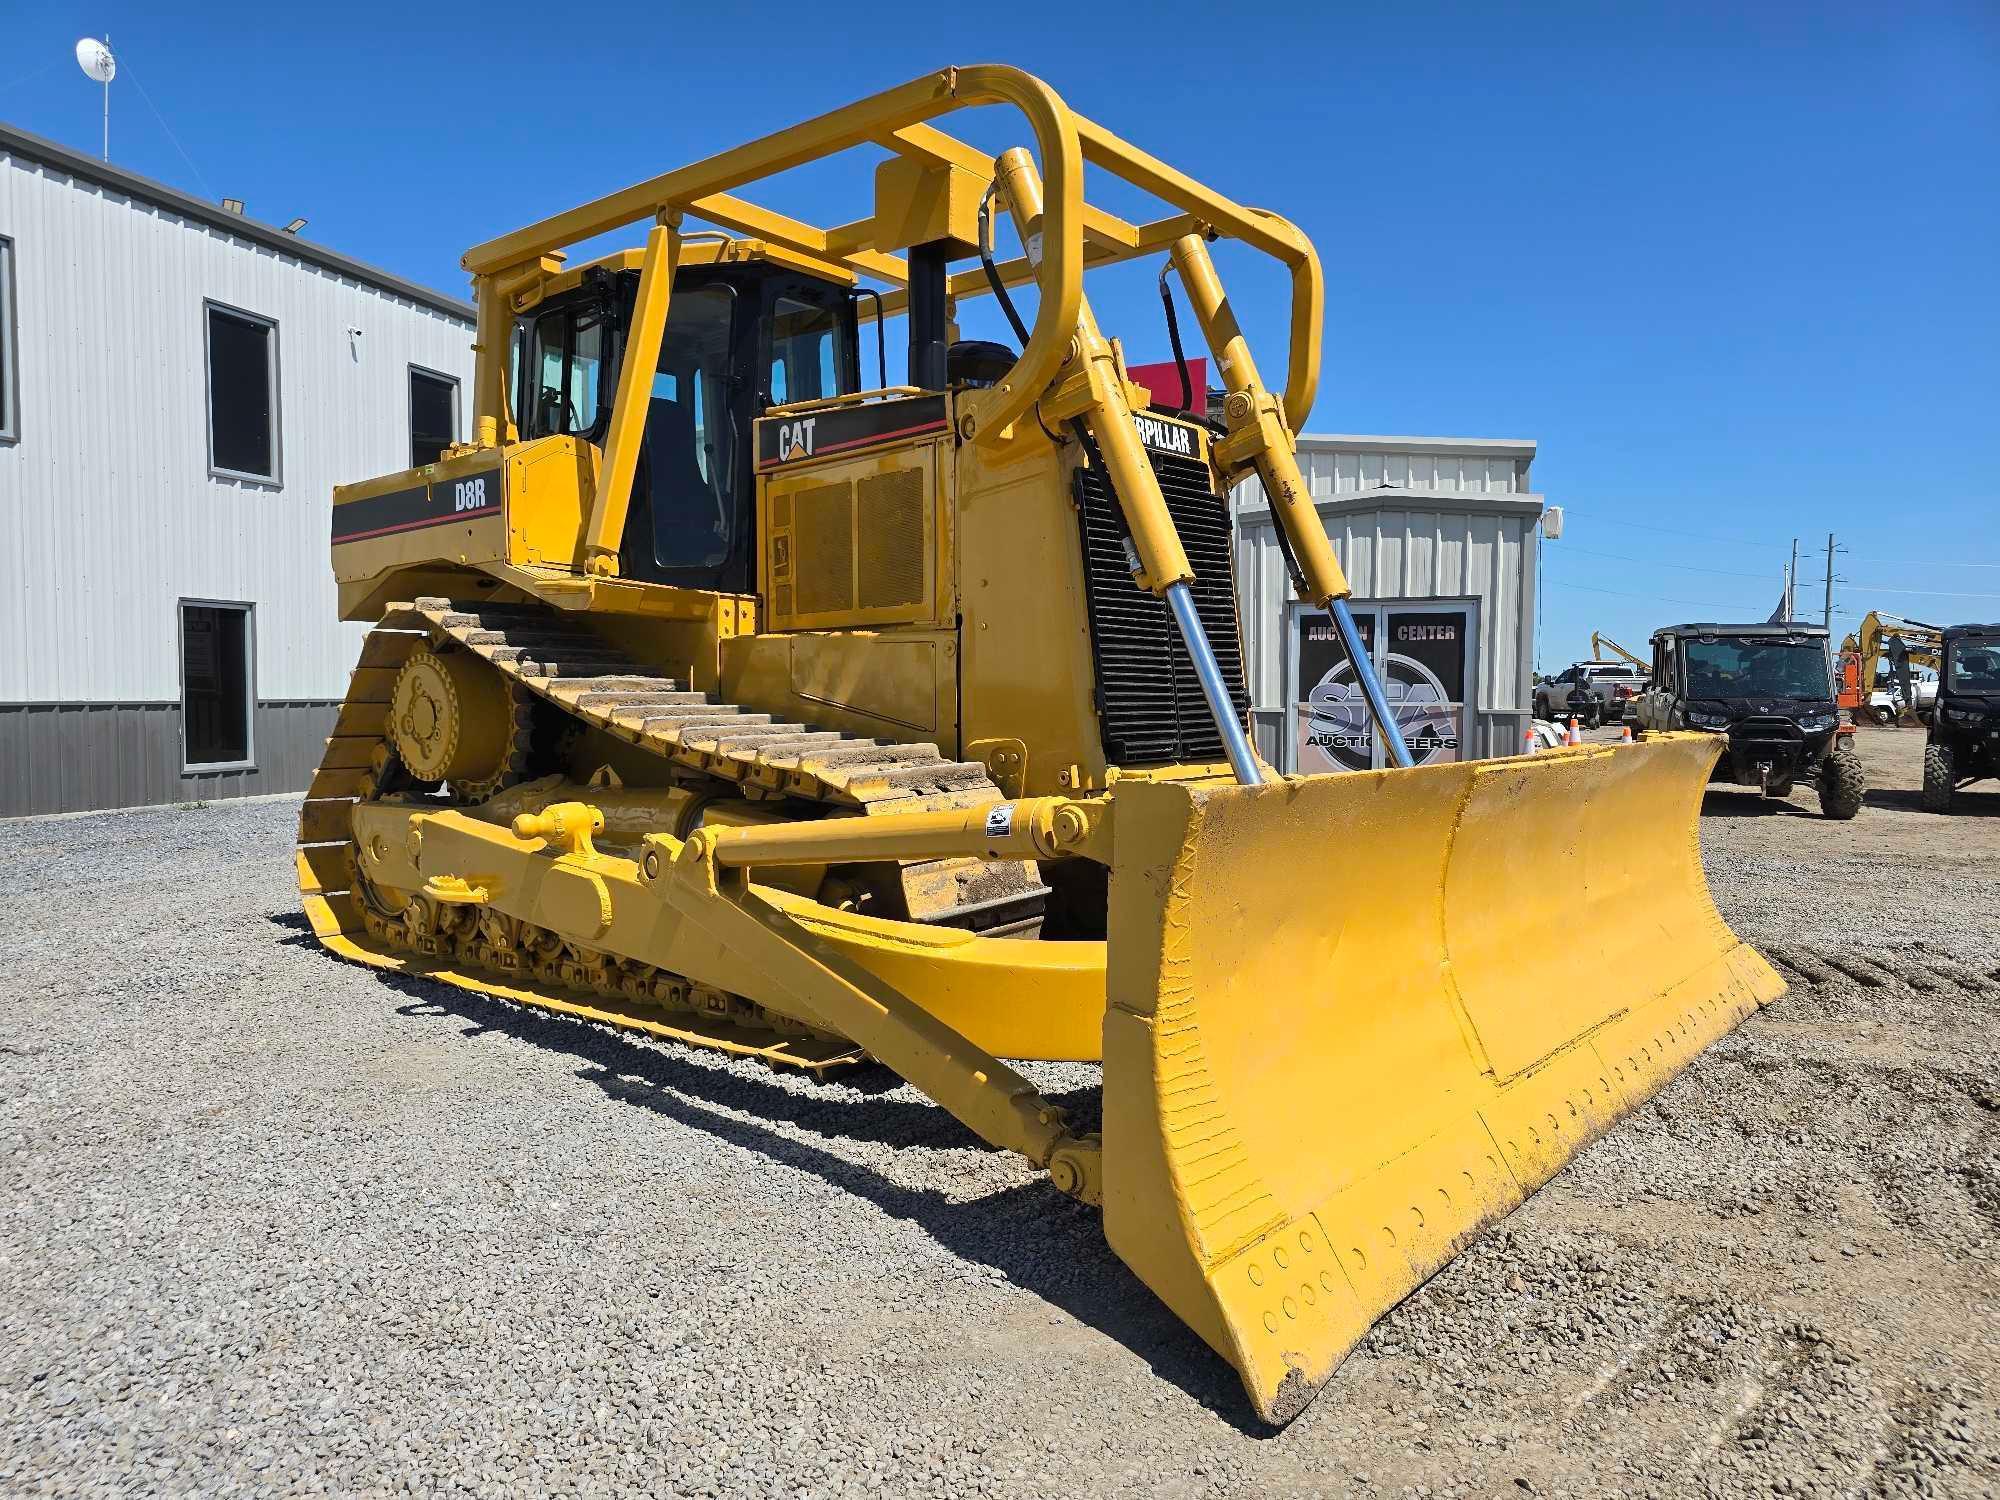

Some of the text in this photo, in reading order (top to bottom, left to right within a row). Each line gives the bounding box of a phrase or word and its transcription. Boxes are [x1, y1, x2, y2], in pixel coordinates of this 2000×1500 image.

[779, 417, 816, 462] CAT
[1132, 415, 1191, 454] RPILLAR
[455, 478, 487, 512] D8R
[1308, 625, 1455, 641] AUCN CENTER
[1305, 735, 1459, 749] AUCTIEERS
